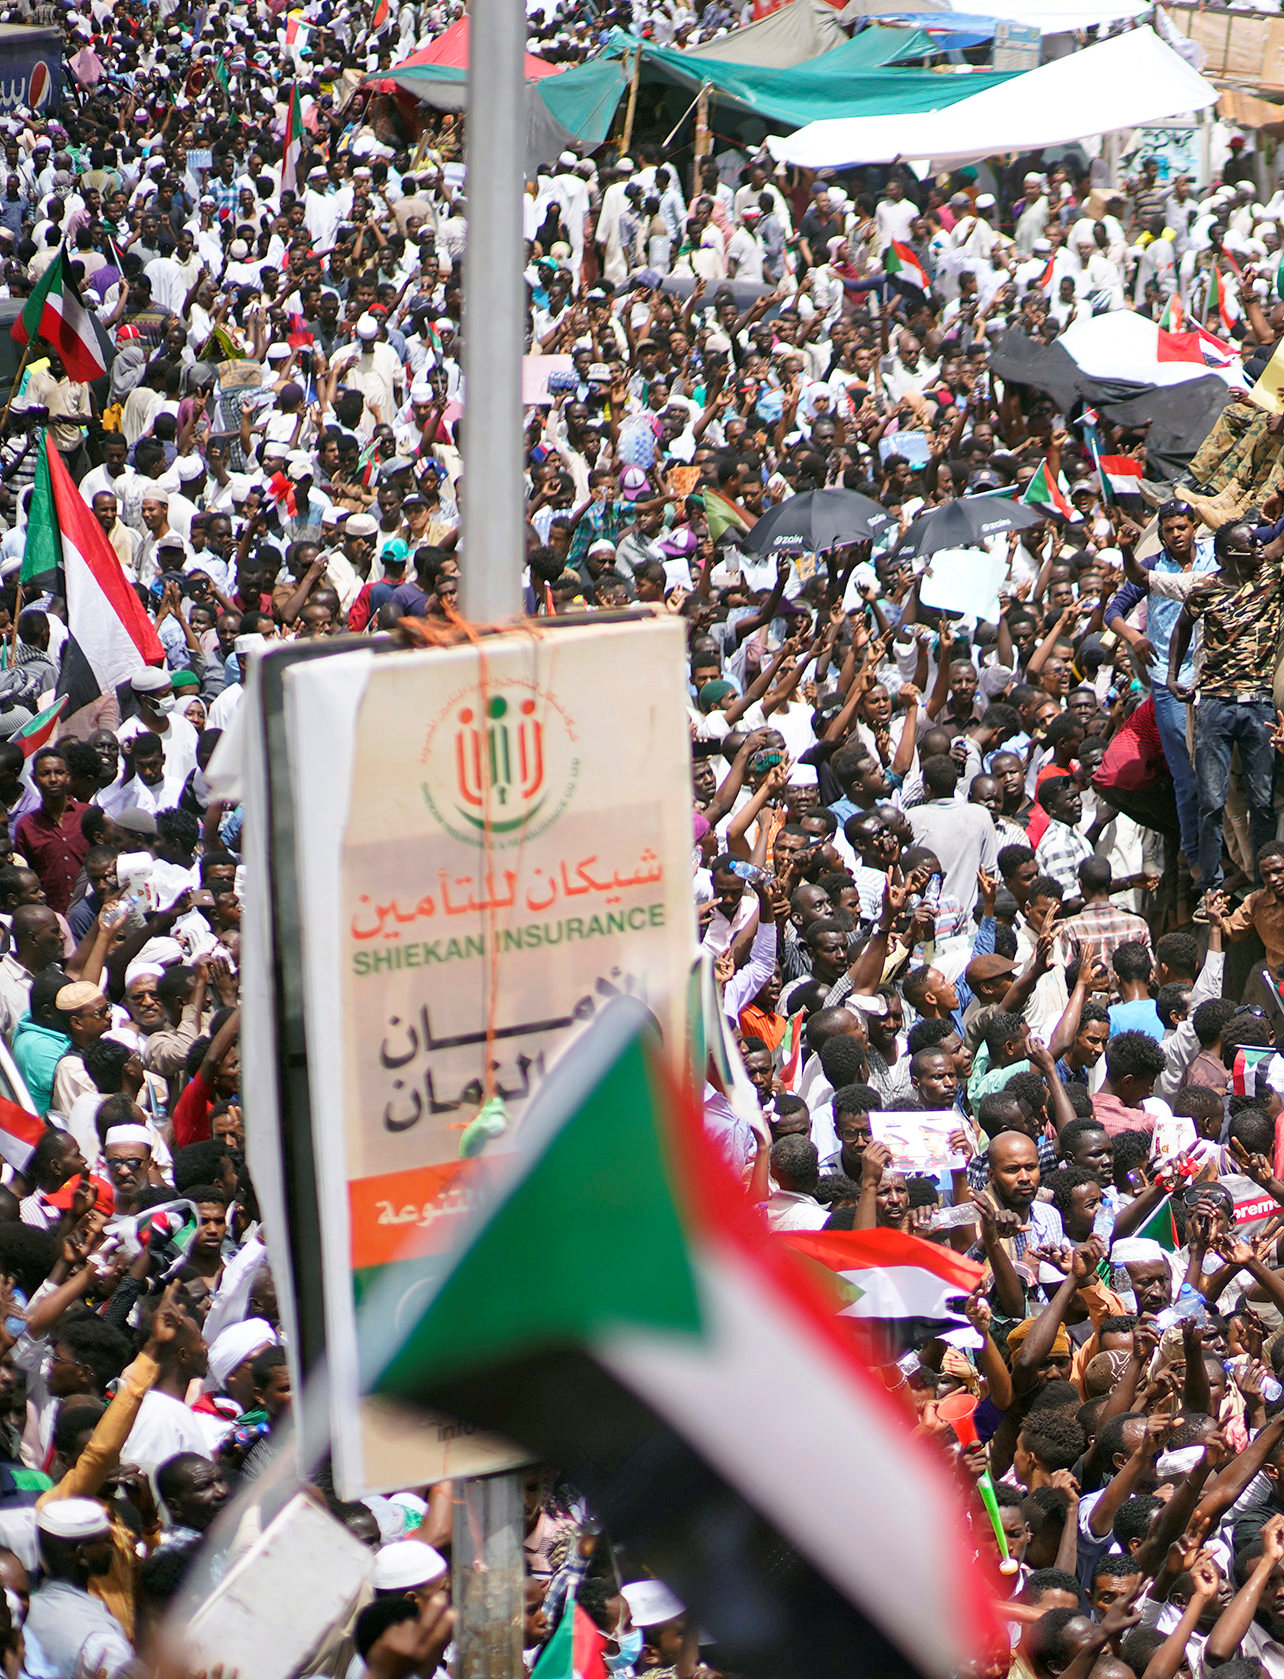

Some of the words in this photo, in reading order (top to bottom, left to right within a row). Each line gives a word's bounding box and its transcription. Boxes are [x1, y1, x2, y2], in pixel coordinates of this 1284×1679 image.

[350, 866, 517, 941] للتأمين
[525, 848, 664, 912] شيكان
[352, 932, 485, 976] SHIEKAN
[494, 903, 666, 953] INSURANCE
